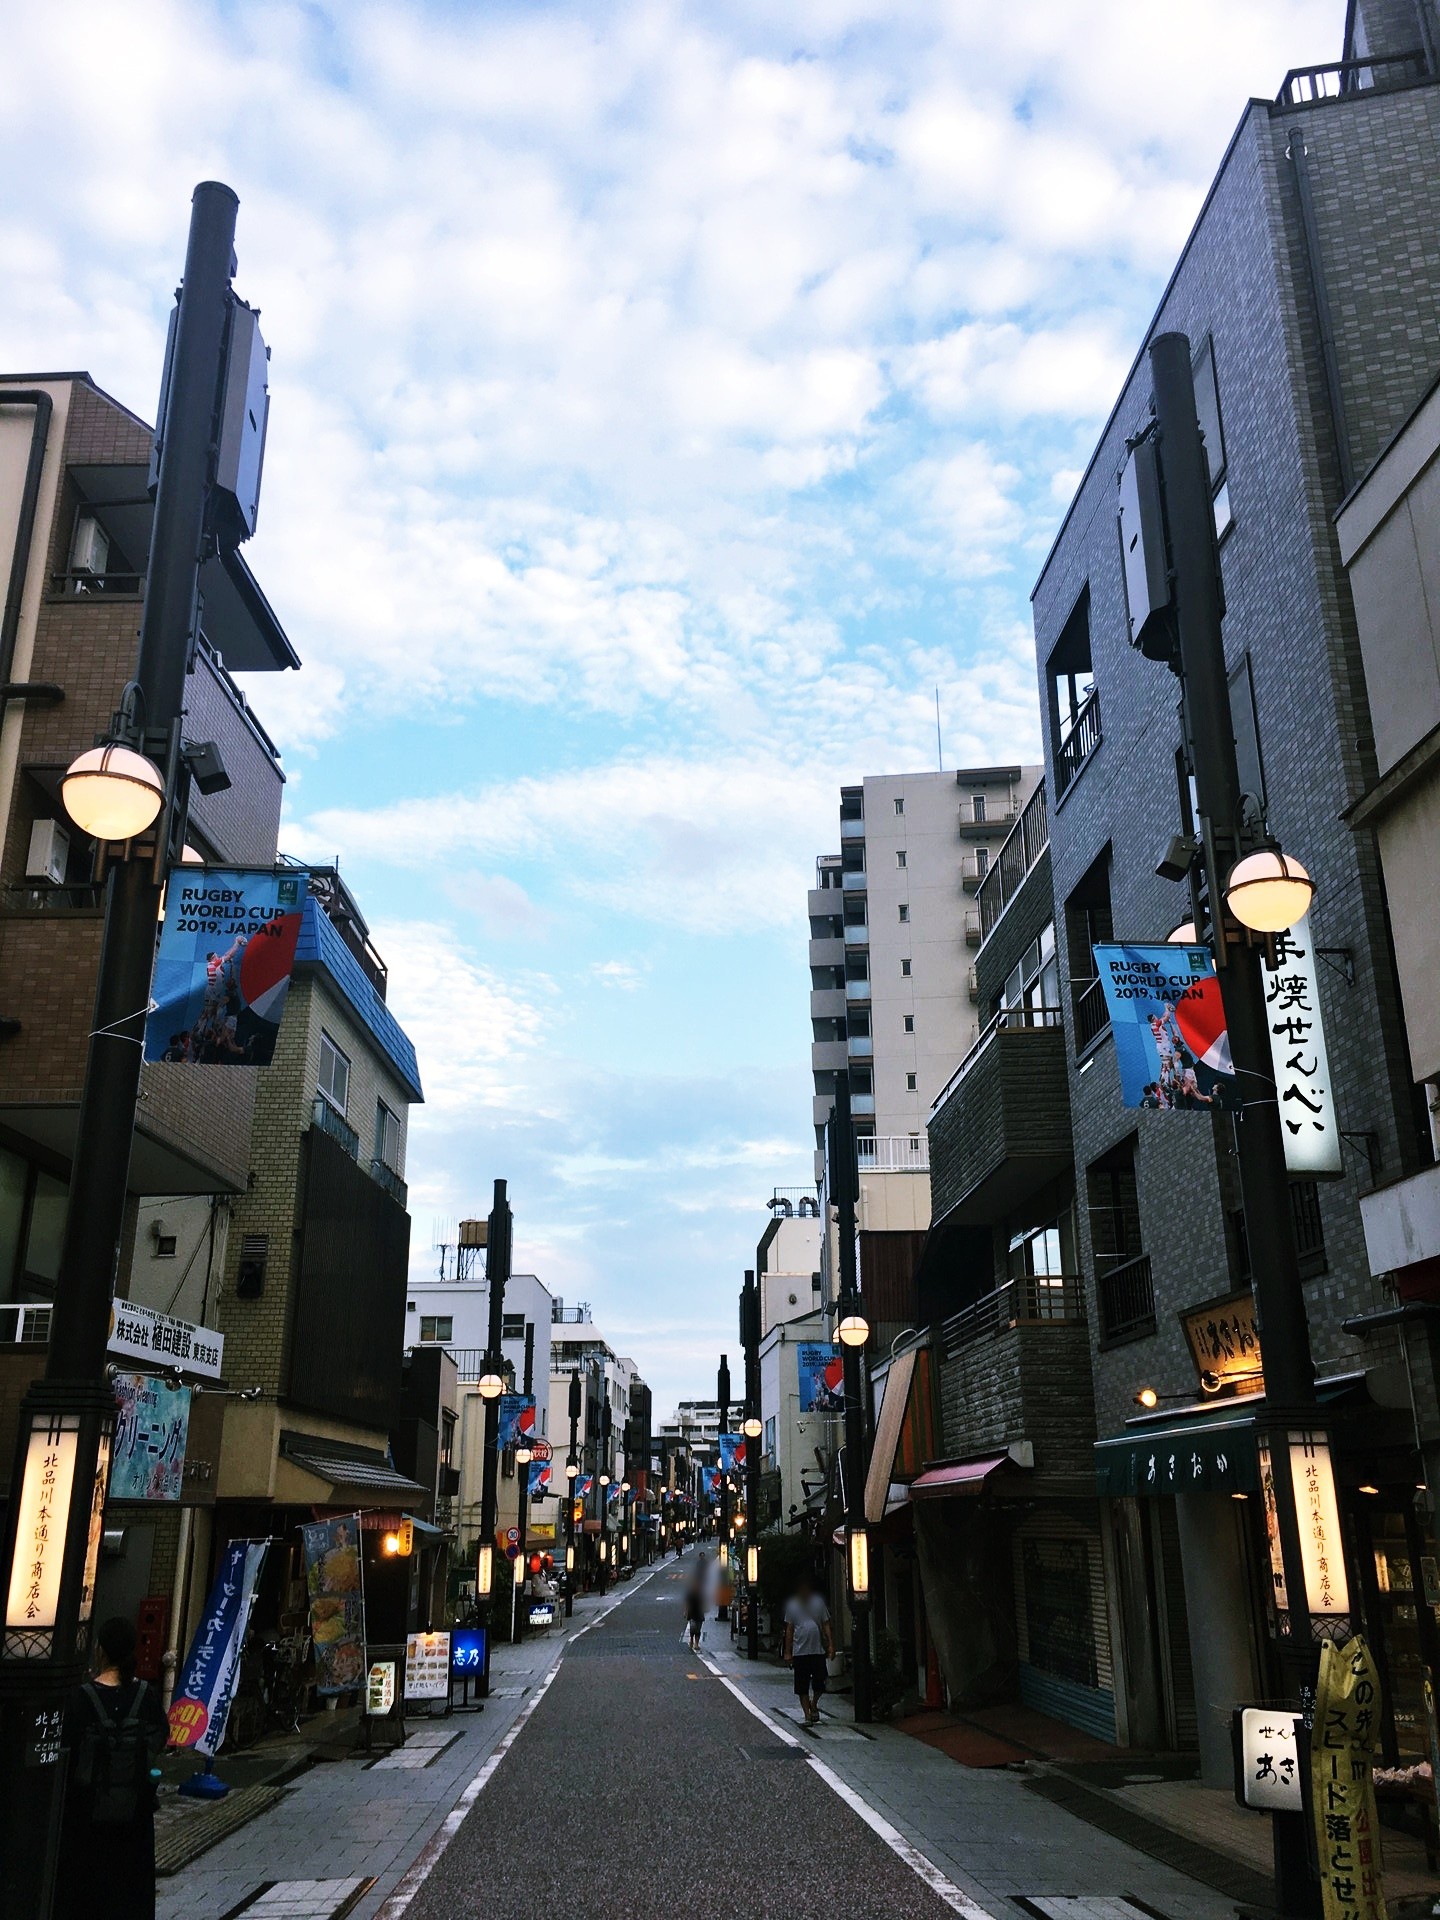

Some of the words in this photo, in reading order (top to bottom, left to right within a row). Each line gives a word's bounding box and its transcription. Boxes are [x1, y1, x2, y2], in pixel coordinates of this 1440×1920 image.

[181, 888, 245, 903] RUGBY
[180, 903, 246, 919] WORLD
[248, 906, 285, 921] CUP
[224, 922, 283, 937] JAPAN
[1109, 961, 1160, 974] RUGBY
[1111, 974, 1167, 988] WORLD
[1168, 975, 1201, 987] CUP
[1155, 988, 1204, 1001] JAPAN
[116, 1317, 149, 1347] 株式会社
[152, 1320, 191, 1360] 植田建設
[192, 1342, 219, 1367] 東京支店
[114, 1410, 183, 1465] クリーニング
[1147, 1452, 1228, 1484] あきおか
[574, 1511, 582, 1522] P
[24, 1453, 58, 1618] 北品川本通り商店会
[509, 1530, 518, 1539] 30
[1305, 1464, 1335, 1607] 北品川本通り商店会
[453, 1646, 479, 1666] 志乃
[1259, 1725, 1296, 1740] せん
